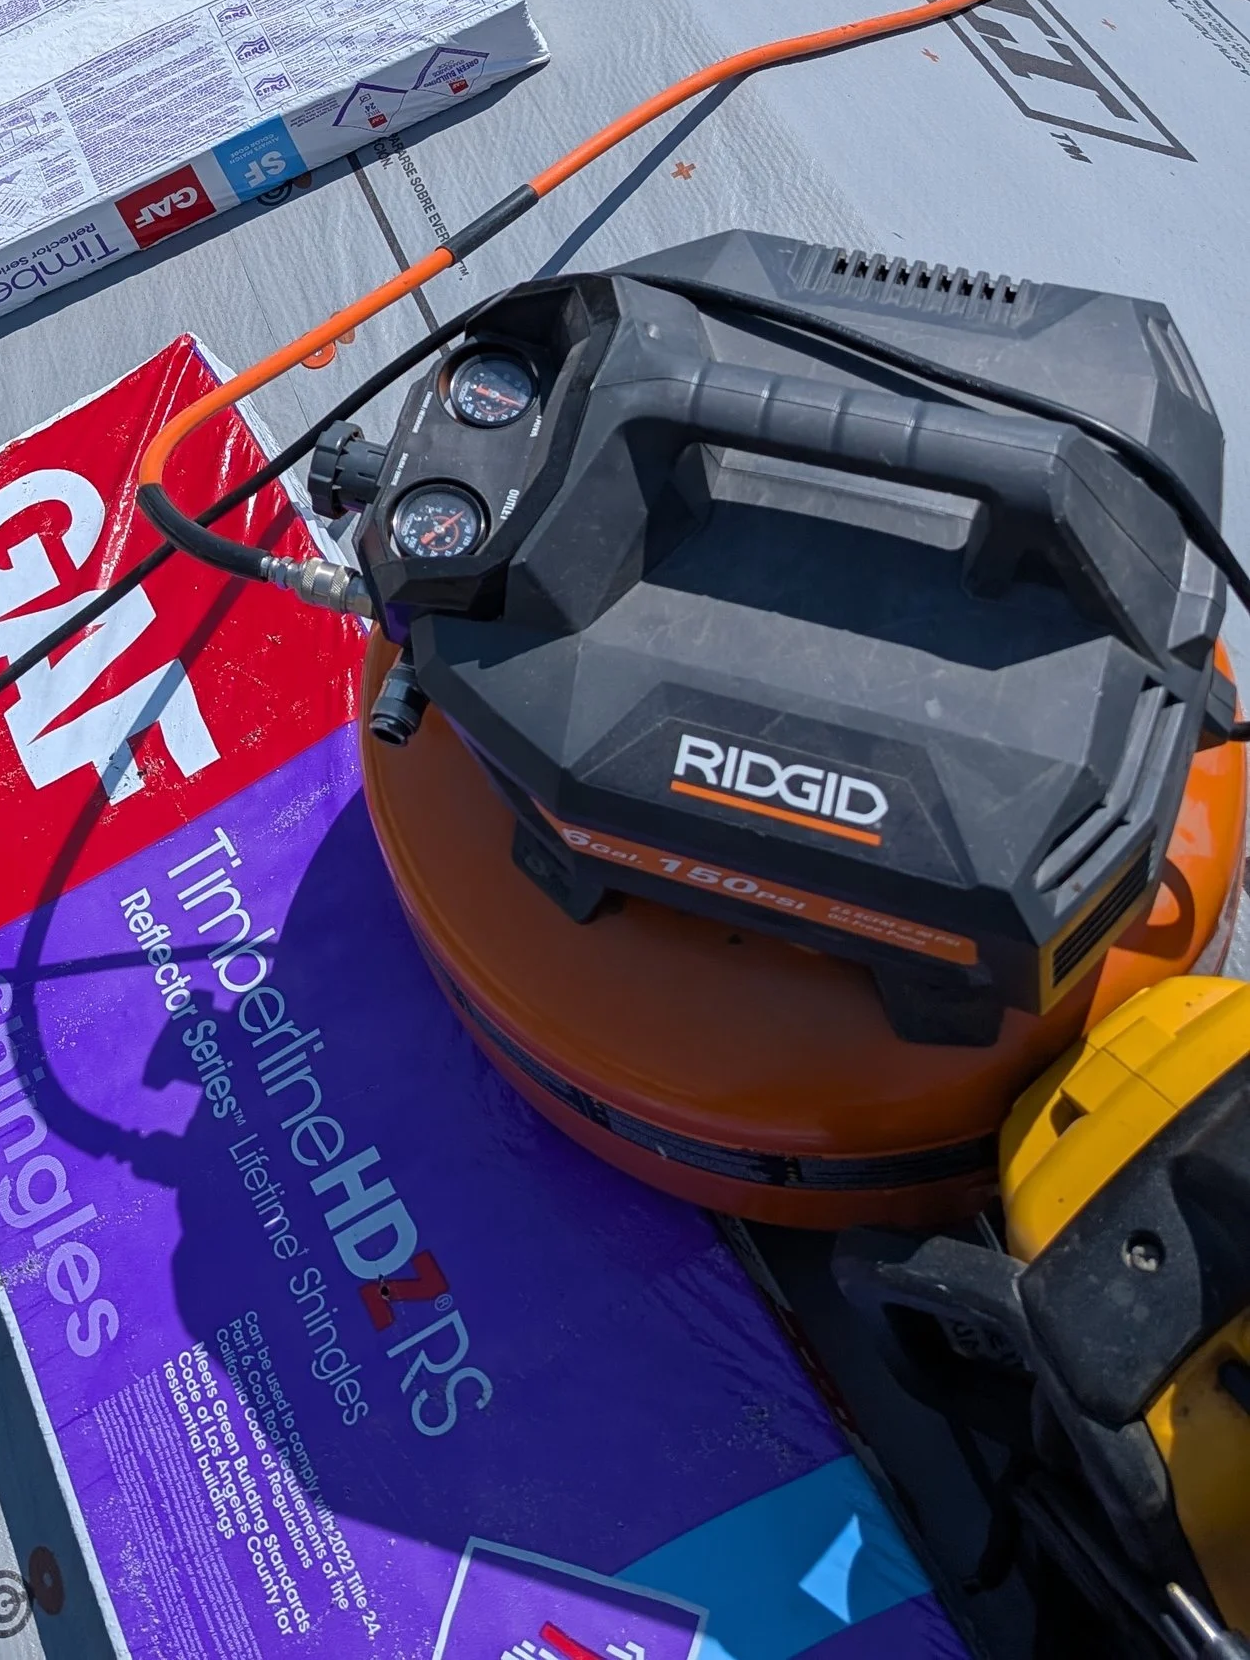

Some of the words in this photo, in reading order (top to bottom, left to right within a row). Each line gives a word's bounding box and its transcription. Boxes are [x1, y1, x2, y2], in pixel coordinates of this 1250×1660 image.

[235, 38, 270, 61] CRRC
[455, 57, 480, 75] GREEN
[422, 68, 457, 92] BUILDING
[239, 147, 290, 189] SF
[127, 181, 203, 233] GAF
[409, 174, 436, 214] SOBRE
[28, 220, 97, 262] Reflector
[674, 734, 889, 826] RIDGID
[120, 887, 198, 1018] Reflector
[288, 1266, 369, 1427] Shingles
[223, 1318, 251, 1354] Part
[237, 1309, 267, 1347] Can
[171, 1349, 207, 1404] Code
[208, 1326, 253, 1407] California
[236, 1352, 258, 1372] 6,
[251, 1345, 276, 1372] be
[387, 1310, 493, 1437] RS
[242, 1368, 273, 1410] Cool
[261, 1370, 292, 1412] used
[192, 1403, 216, 1426] of
[237, 1404, 270, 1453] Code
[257, 1407, 287, 1447] Roof
[277, 1409, 300, 1430] to
[160, 1358, 208, 1454] residential
[192, 1453, 238, 1541] buildings
[200, 1424, 228, 1458] Los
[254, 1451, 277, 1472] of
[285, 1427, 327, 1493] comply
[183, 1340, 224, 1400] Meets
[206, 1396, 246, 1457] Green
[228, 1453, 275, 1534] Building
[257, 1531, 314, 1635] Standards
[212, 1456, 257, 1535] Angeles
[272, 1445, 333, 1560] Requirements
[261, 1470, 315, 1571] Regulations
[312, 1490, 344, 1531] with
[241, 1533, 284, 1607] County
[318, 1558, 342, 1582] of
[327, 1526, 360, 1573] 2022
[325, 1578, 353, 1612] the
[343, 1569, 373, 1609] Title
[269, 1605, 297, 1638] for
[358, 1609, 385, 1641] 24,
